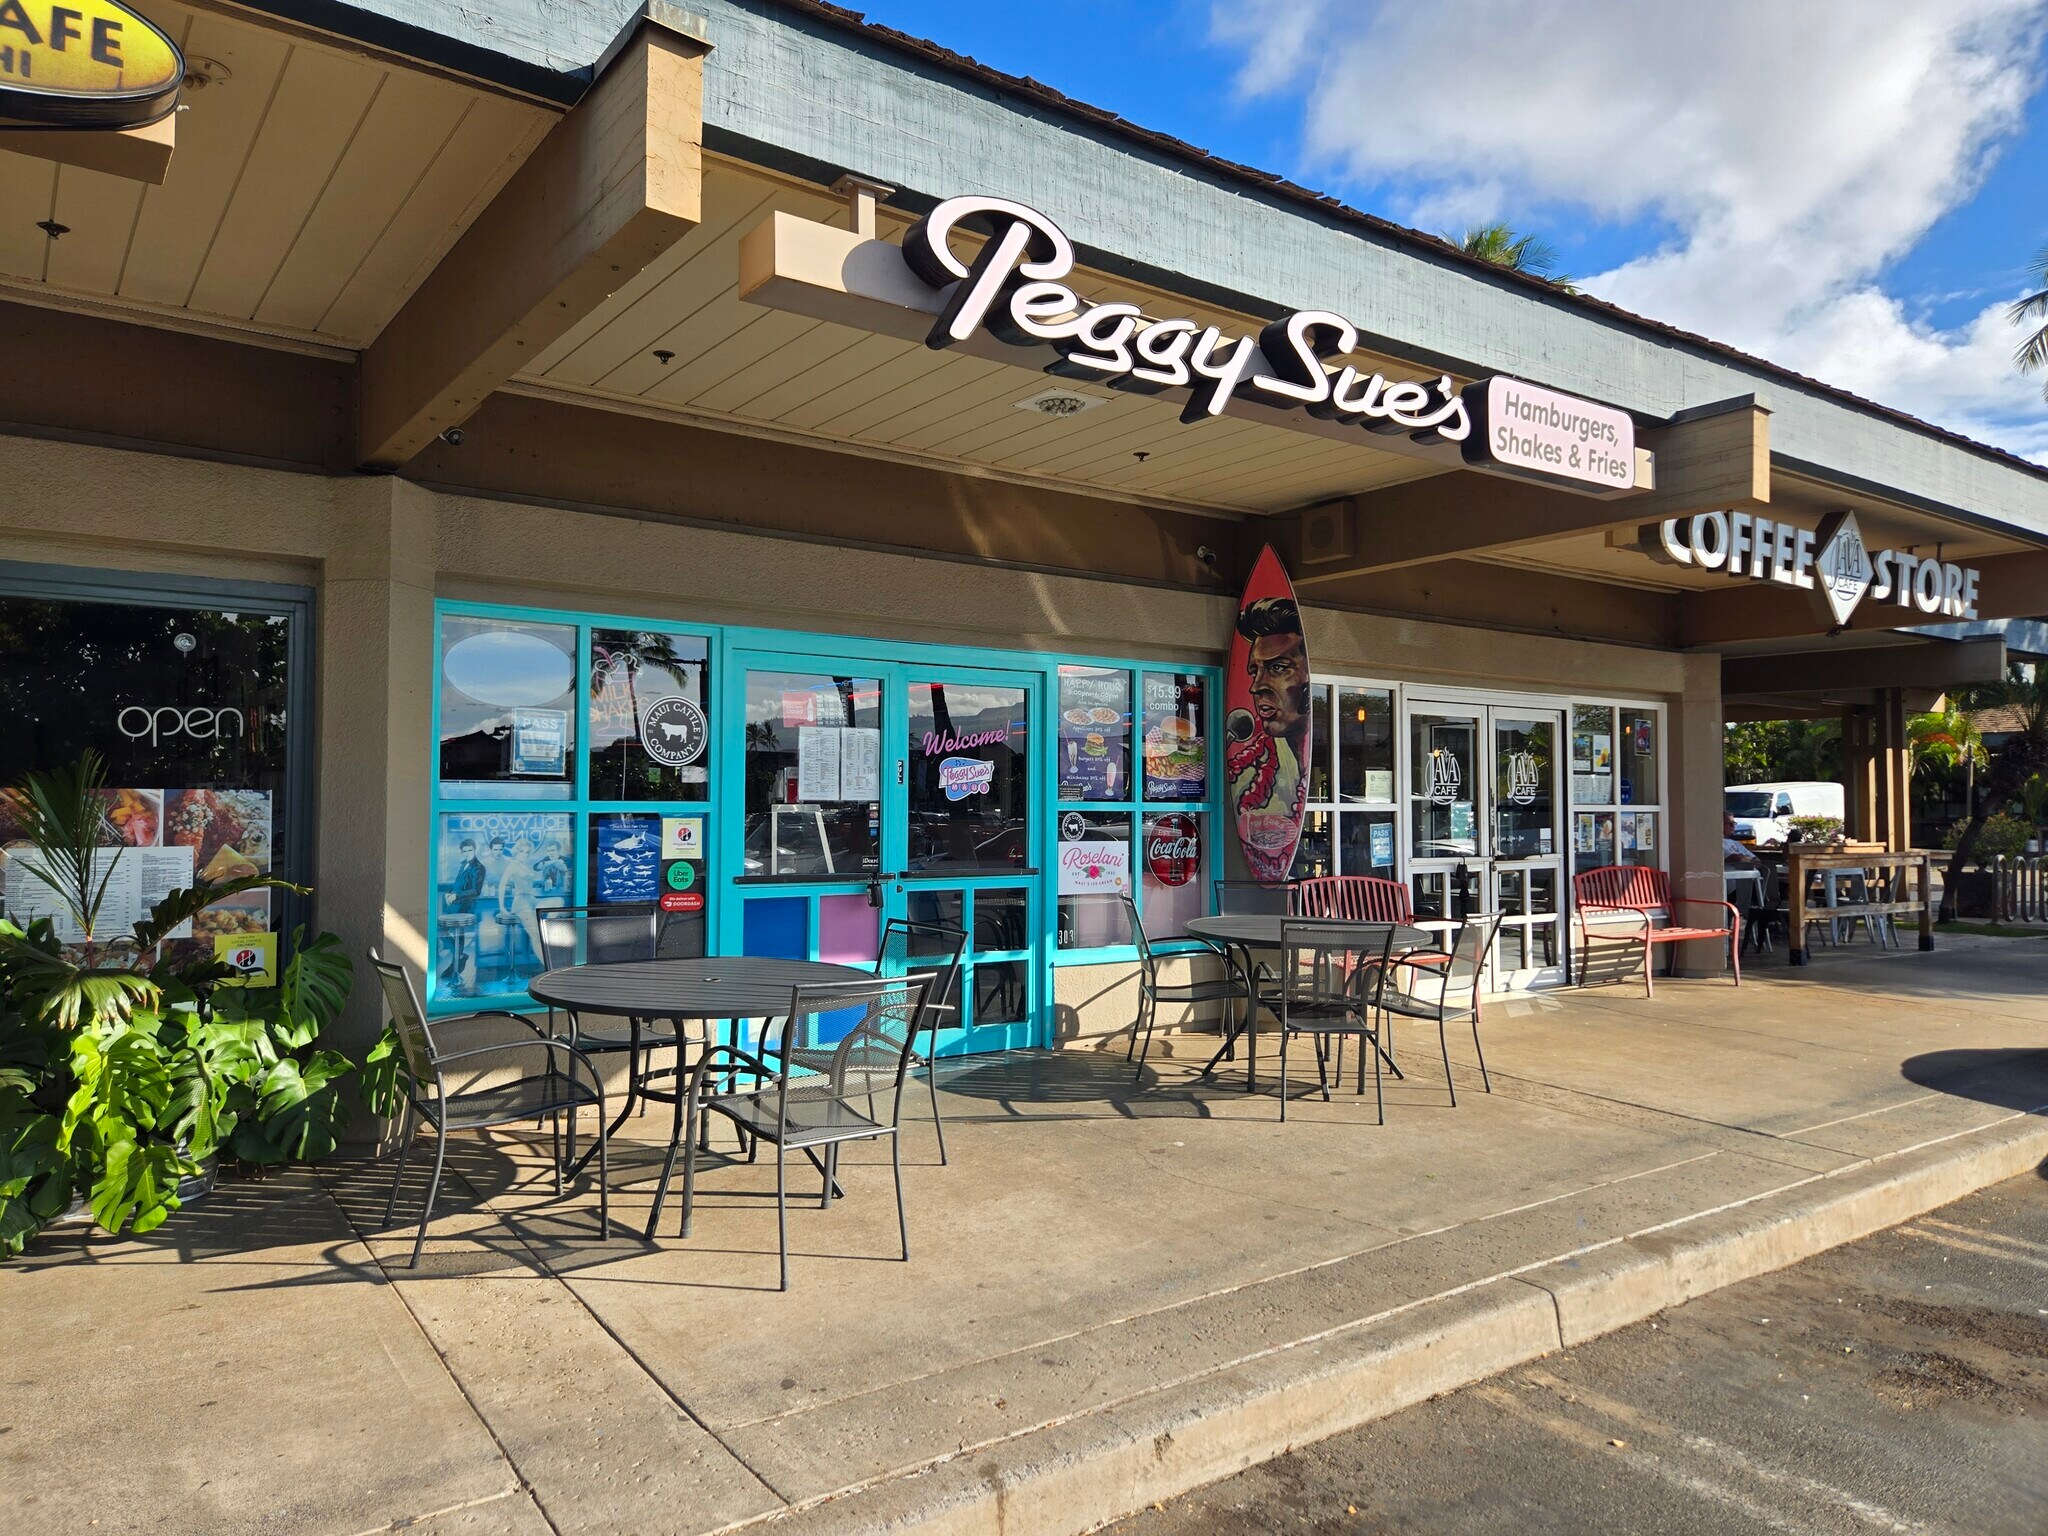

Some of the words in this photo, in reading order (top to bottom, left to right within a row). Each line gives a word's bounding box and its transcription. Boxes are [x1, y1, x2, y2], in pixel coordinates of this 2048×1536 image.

[926, 194, 1256, 416] Peggy
[1253, 310, 1472, 441] Sue's
[1504, 391, 1619, 447] Hamburgers,
[1496, 426, 1563, 464] Shakes
[1568, 444, 1581, 469] &
[1588, 448, 1627, 479] Fries
[1661, 510, 1817, 590] COFFEE
[1872, 549, 1980, 620] STORE
[1837, 577, 1858, 591] CAFE
[1063, 678, 1095, 690] HAPPY
[1098, 679, 1122, 693] HOUR
[1147, 684, 1182, 699] $15.99
[648, 703, 671, 728] MAUI
[672, 702, 701, 734] CATTLE
[1150, 701, 1179, 711] combo
[117, 706, 244, 748] open
[523, 718, 558, 730] PASS
[650, 737, 696, 760] COMPANY
[922, 719, 1011, 757] Welcome!
[943, 766, 969, 782] Peggy
[968, 765, 990, 780] Sue's
[1425, 752, 1459, 797] JAVA
[1507, 754, 1536, 799] JAVA
[1434, 786, 1458, 796] CAFE
[1515, 786, 1536, 796] CAFE
[1373, 829, 1389, 838] PASS
[1062, 846, 1125, 870] Roselani
[1149, 836, 1199, 860] Coca-Cola
